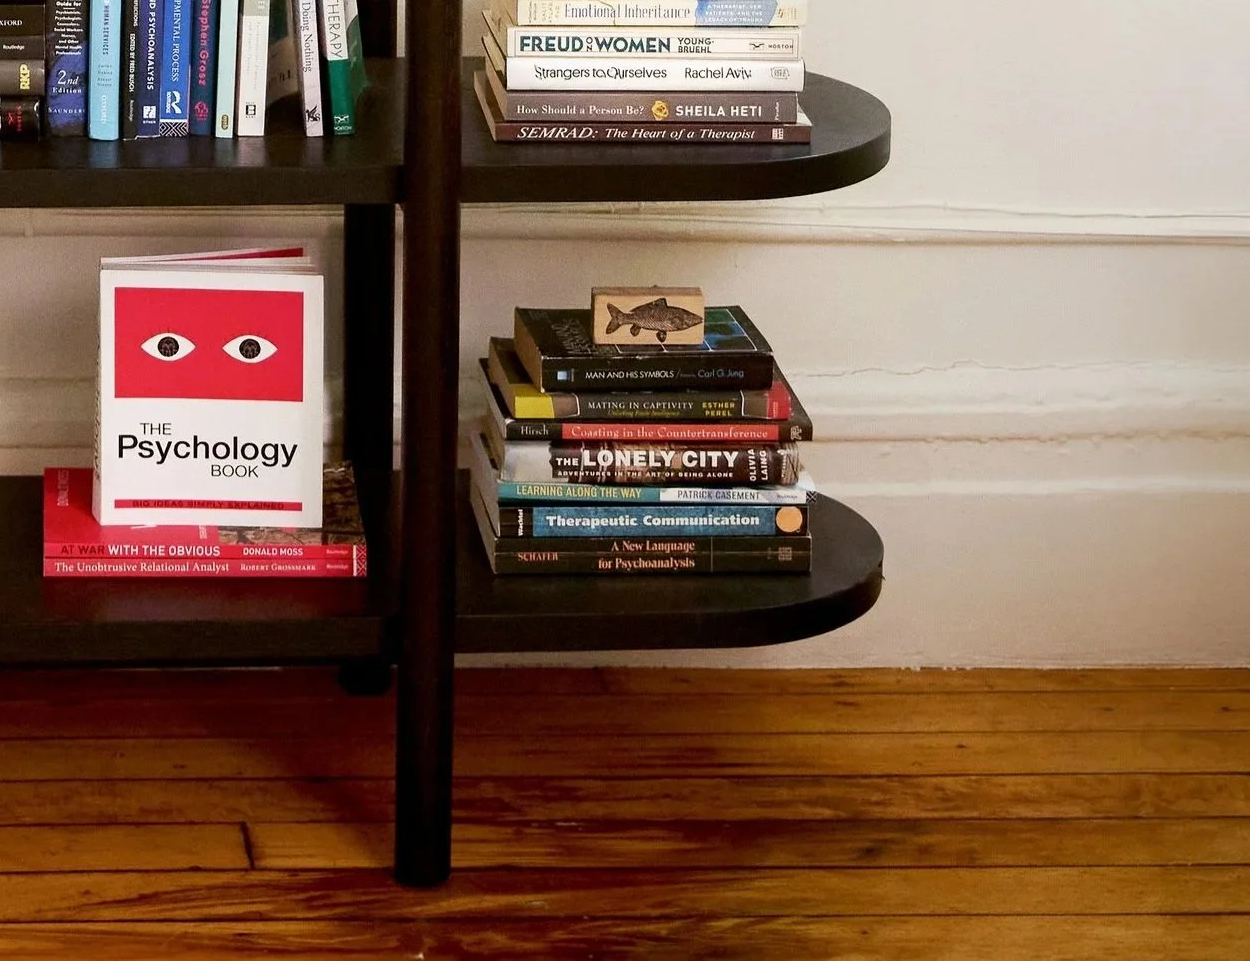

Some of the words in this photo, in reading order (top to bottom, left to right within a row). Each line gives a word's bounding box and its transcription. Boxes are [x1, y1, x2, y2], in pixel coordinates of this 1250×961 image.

[565, 4, 620, 18] Emotional
[625, 4, 690, 18] Inheritance
[147, 11, 156, 90] PSYCHOANALYSIS
[520, 36, 583, 51] FREUD
[594, 38, 671, 52] WOMEN
[199, 48, 209, 86] Grosz
[517, 105, 538, 114] How
[542, 105, 576, 114] Should
[589, 106, 622, 114] Person
[626, 105, 644, 115] Be?
[676, 106, 725, 116] SHEILA
[731, 106, 761, 116] HETI
[517, 127, 599, 138] SEMRAD:
[606, 129, 627, 138] The
[631, 128, 666, 138] Heart
[670, 129, 686, 140] of
[700, 129, 756, 140] Therapist
[640, 370, 674, 378] SYMBOLS
[140, 423, 172, 435] THE
[118, 434, 298, 468] Psychology
[556, 458, 579, 466] THE
[583, 450, 675, 466] LONELY
[682, 451, 738, 467] CITY
[211, 465, 258, 477] BOOK
[678, 490, 712, 499] PATRICK
[715, 491, 760, 500] CASEMENT
[546, 515, 638, 529] Therapeutic
[643, 515, 760, 526] Communication
[108, 545, 139, 555] WITH
[142, 545, 165, 555] THE
[168, 546, 220, 556] OBVIOUS
